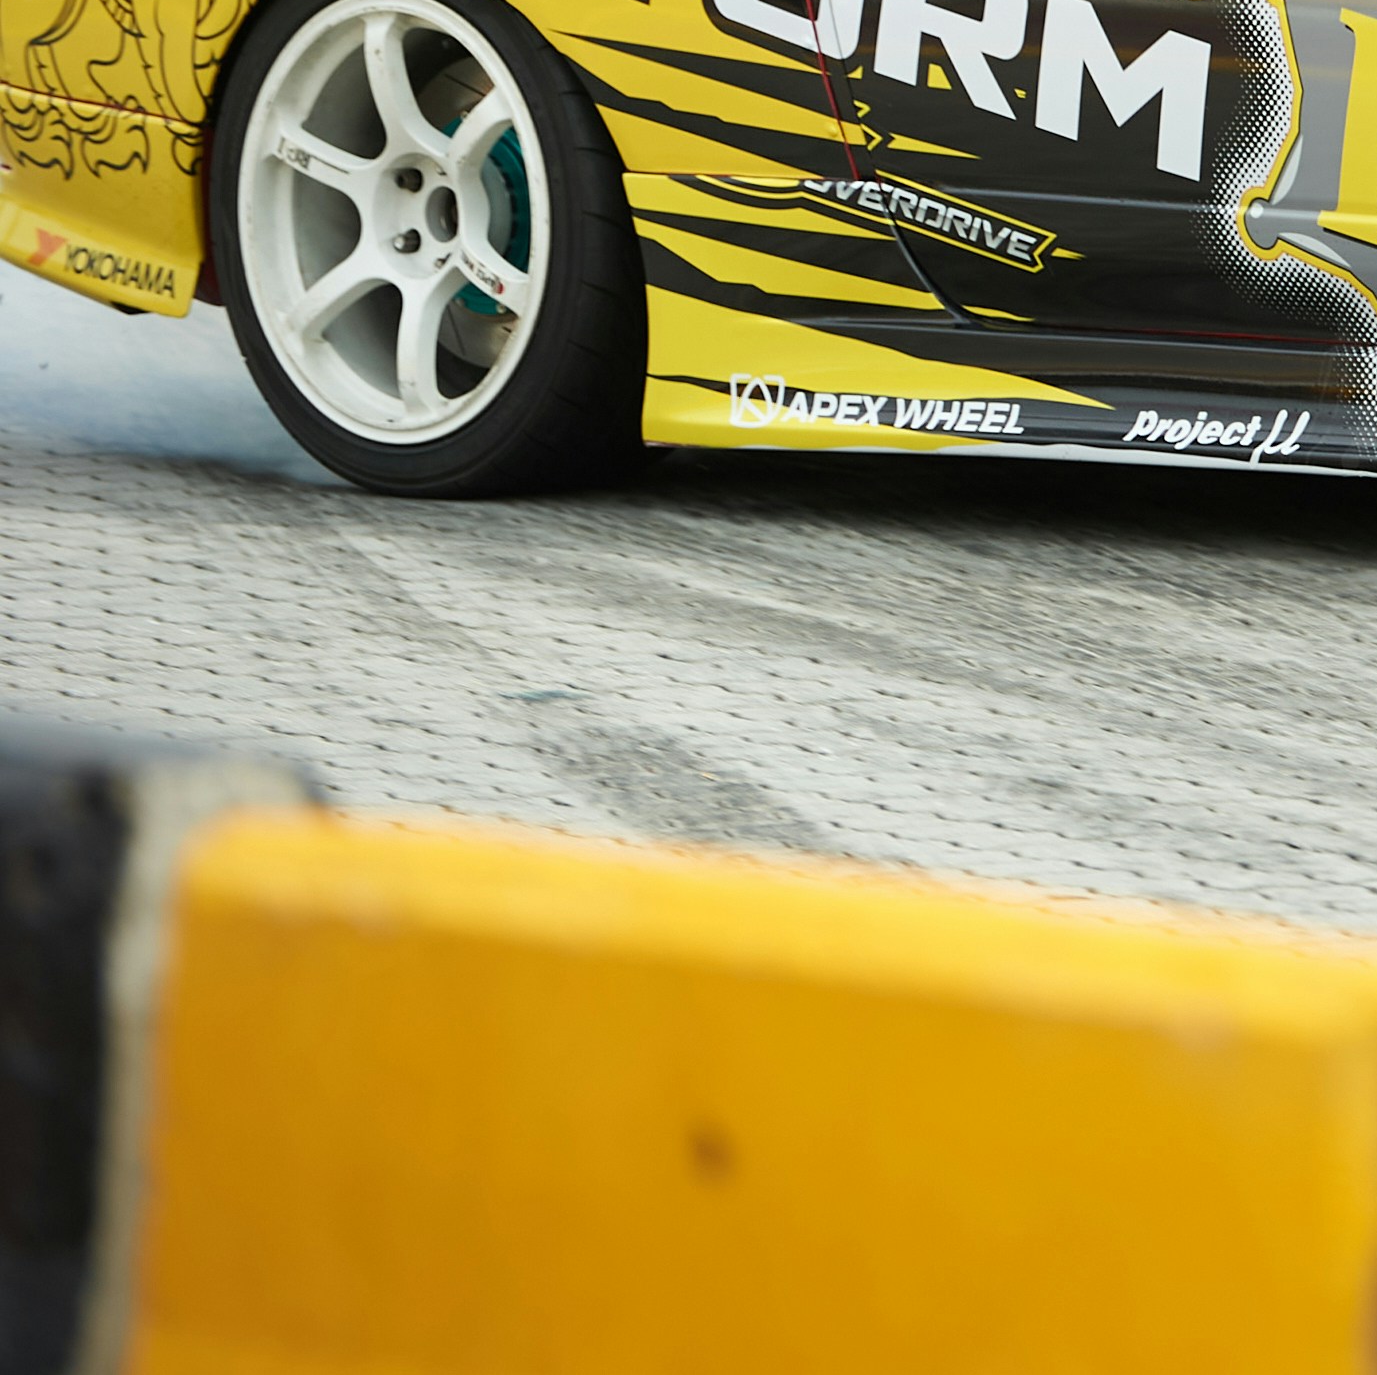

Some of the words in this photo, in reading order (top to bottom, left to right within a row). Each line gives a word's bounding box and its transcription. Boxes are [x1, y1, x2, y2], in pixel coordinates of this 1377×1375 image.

[64, 244, 176, 299] YOKOHAMA
[781, 391, 888, 428] APEX
[894, 397, 1024, 435] WHEEL
[1122, 410, 1262, 450] Project
